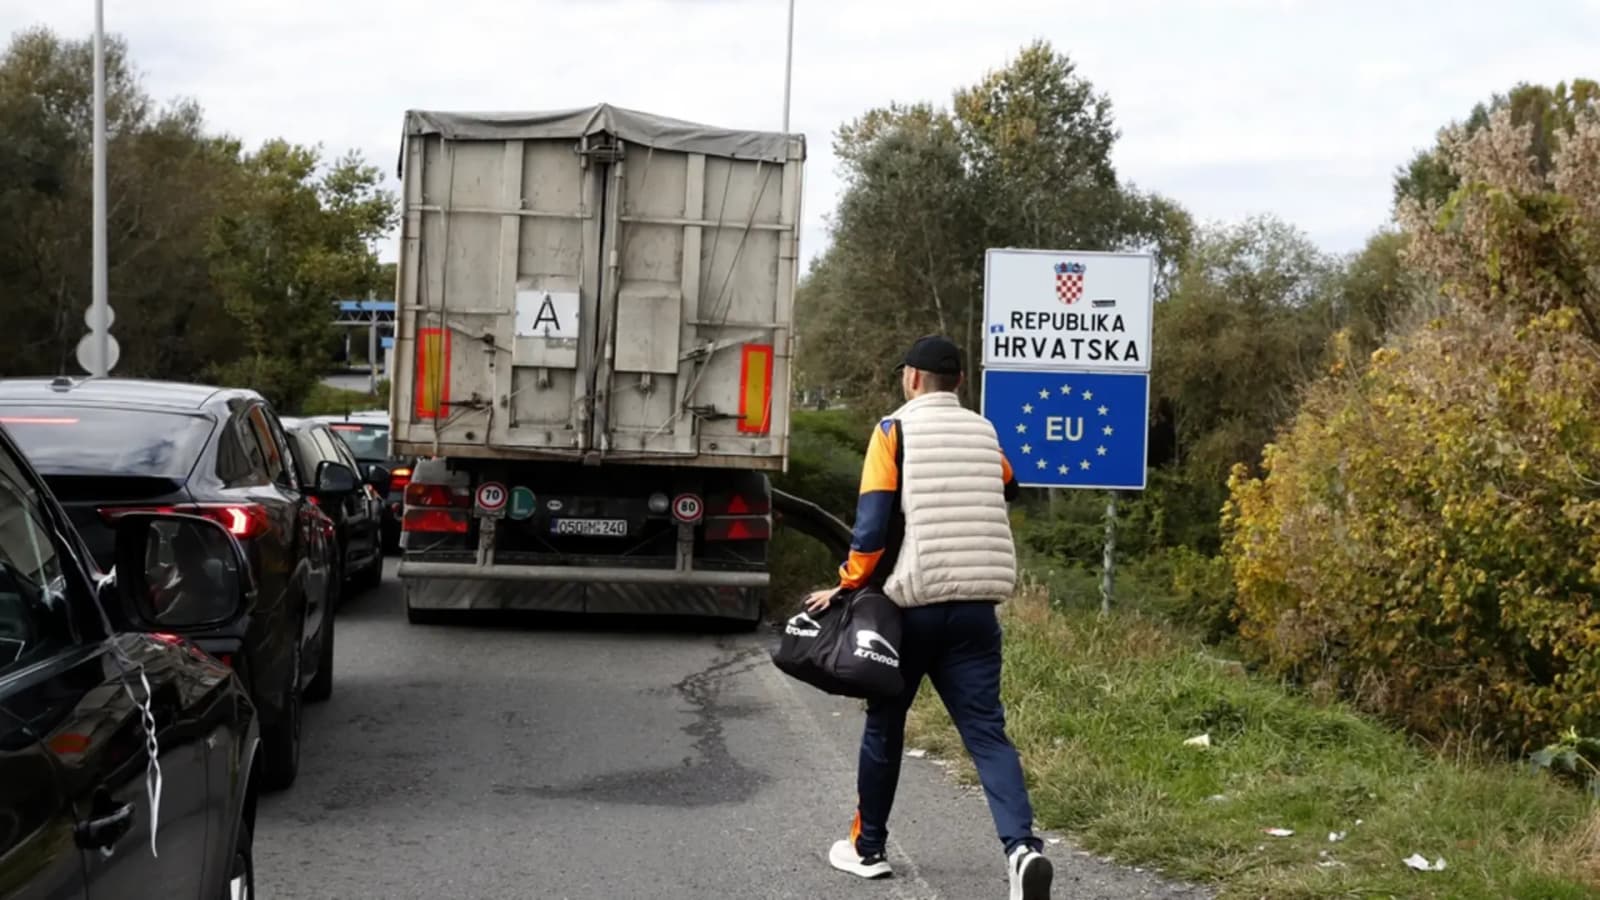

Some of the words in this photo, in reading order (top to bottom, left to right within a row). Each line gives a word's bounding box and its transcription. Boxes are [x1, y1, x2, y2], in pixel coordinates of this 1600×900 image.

[532, 294, 561, 330] A
[1010, 311, 1125, 332] REPUBLIKA
[994, 336, 1140, 362] HRVATSKA
[1046, 416, 1083, 441] EU
[485, 489, 500, 501] 70
[513, 491, 529, 514] L
[681, 500, 696, 512] 80
